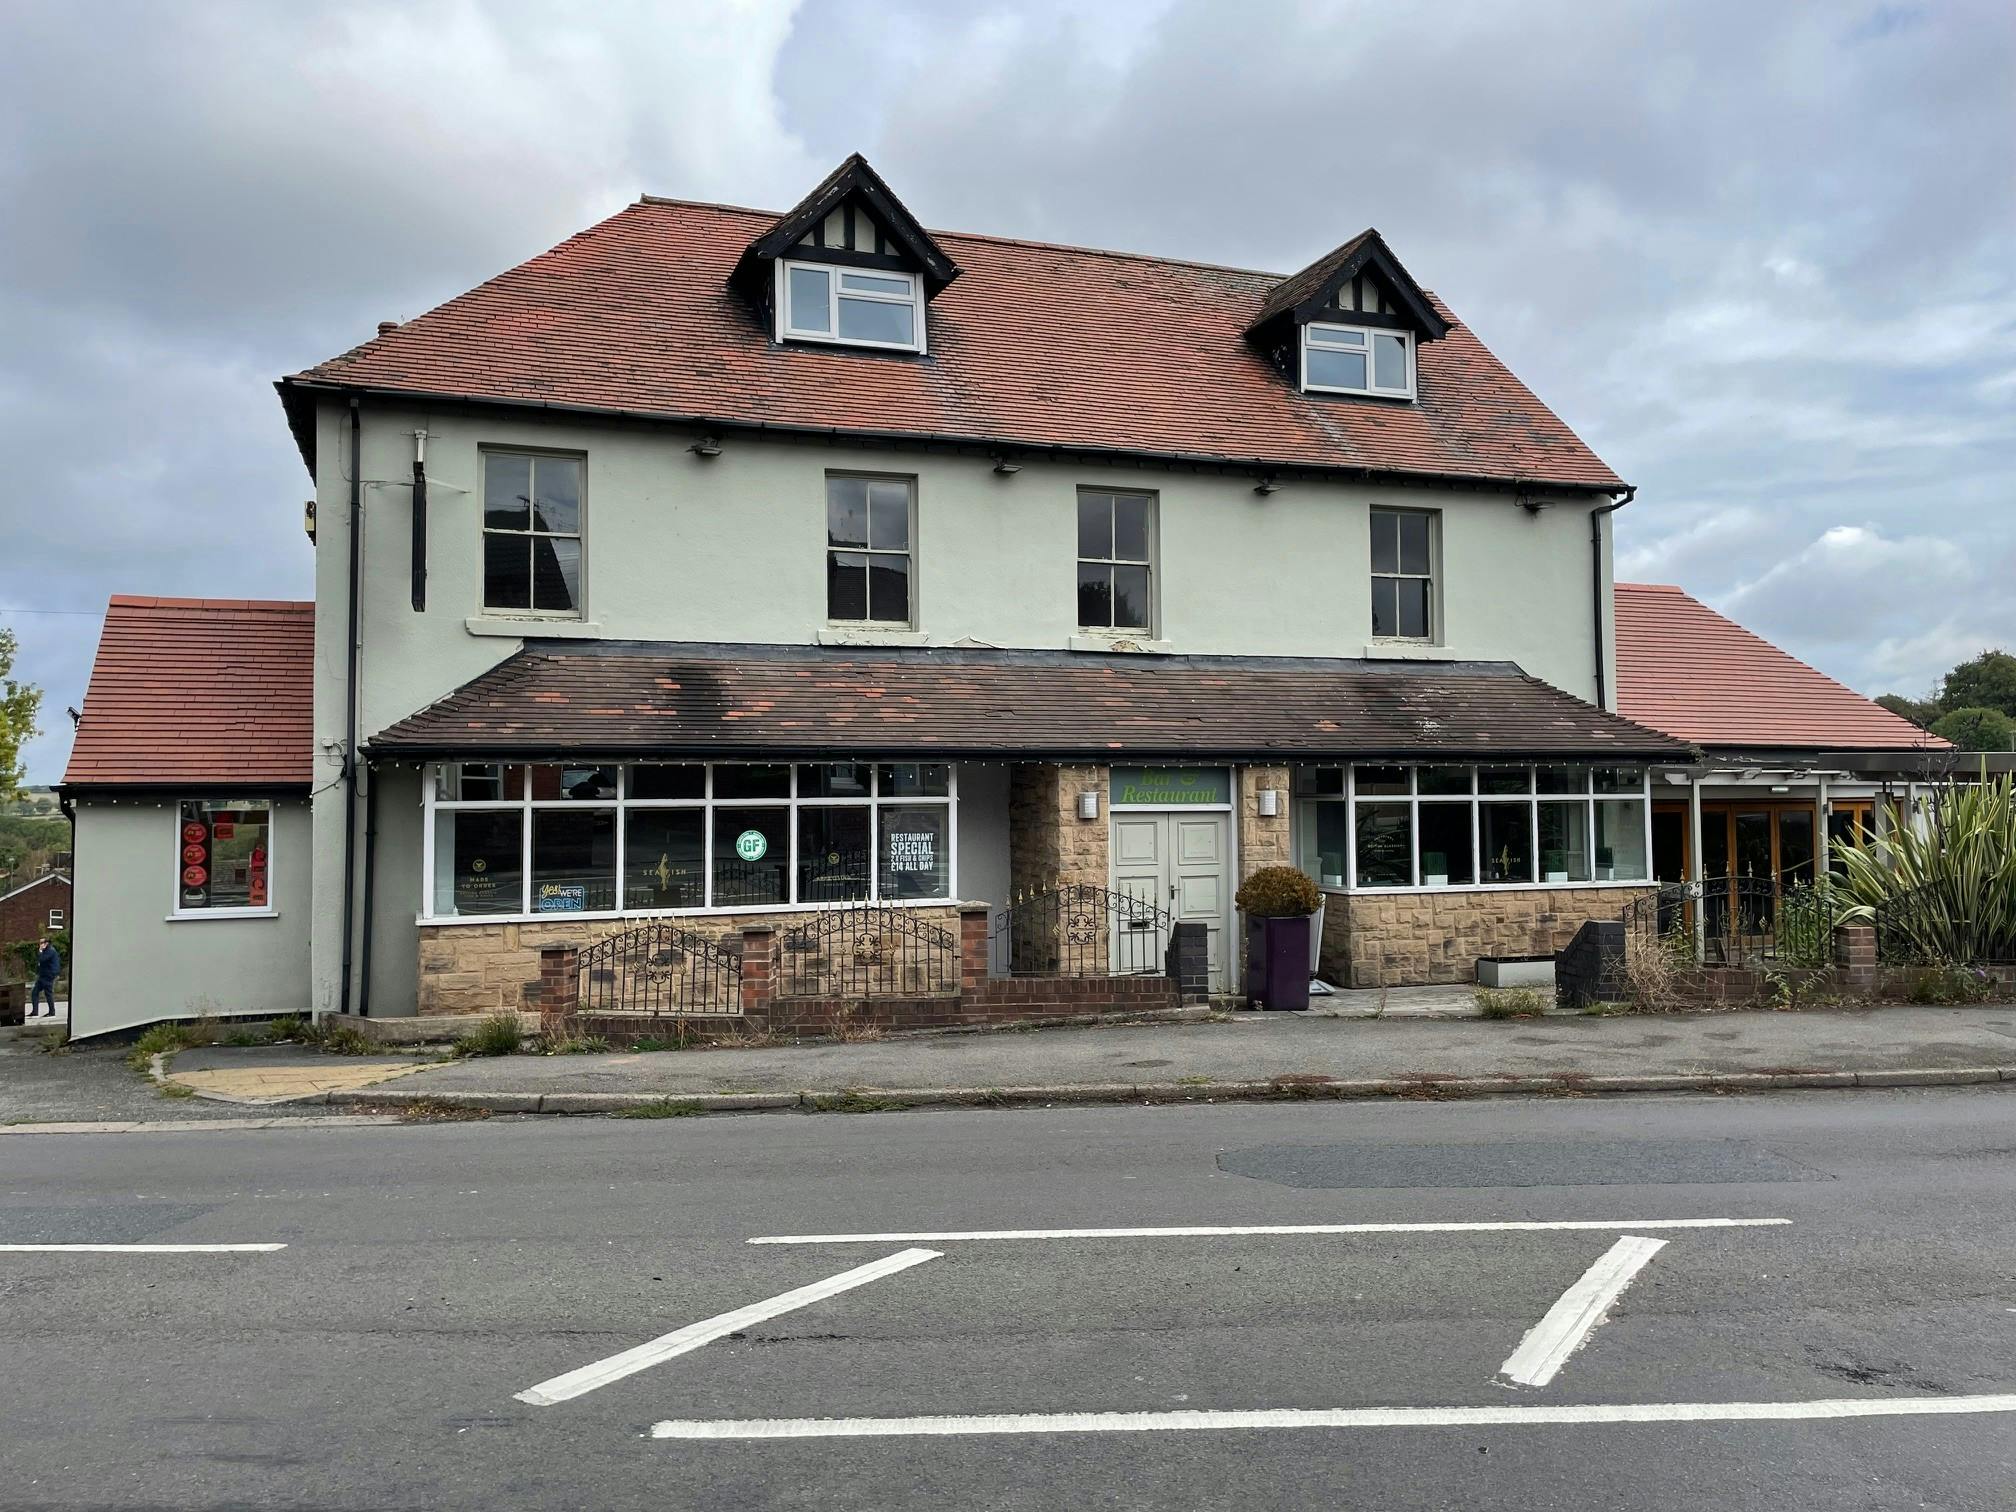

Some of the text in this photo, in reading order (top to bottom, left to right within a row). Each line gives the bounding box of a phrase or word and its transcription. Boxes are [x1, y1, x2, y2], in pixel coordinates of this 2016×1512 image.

[1140, 768, 1172, 785] Bar
[1120, 784, 1217, 803] Restaurant
[891, 832, 934, 841] RESTAURANT
[743, 839, 760, 852] GF
[891, 841, 934, 855] SPECIAL
[905, 862, 918, 871] ALL
[919, 861, 934, 870] DAY
[541, 898, 582, 911] OPEN
